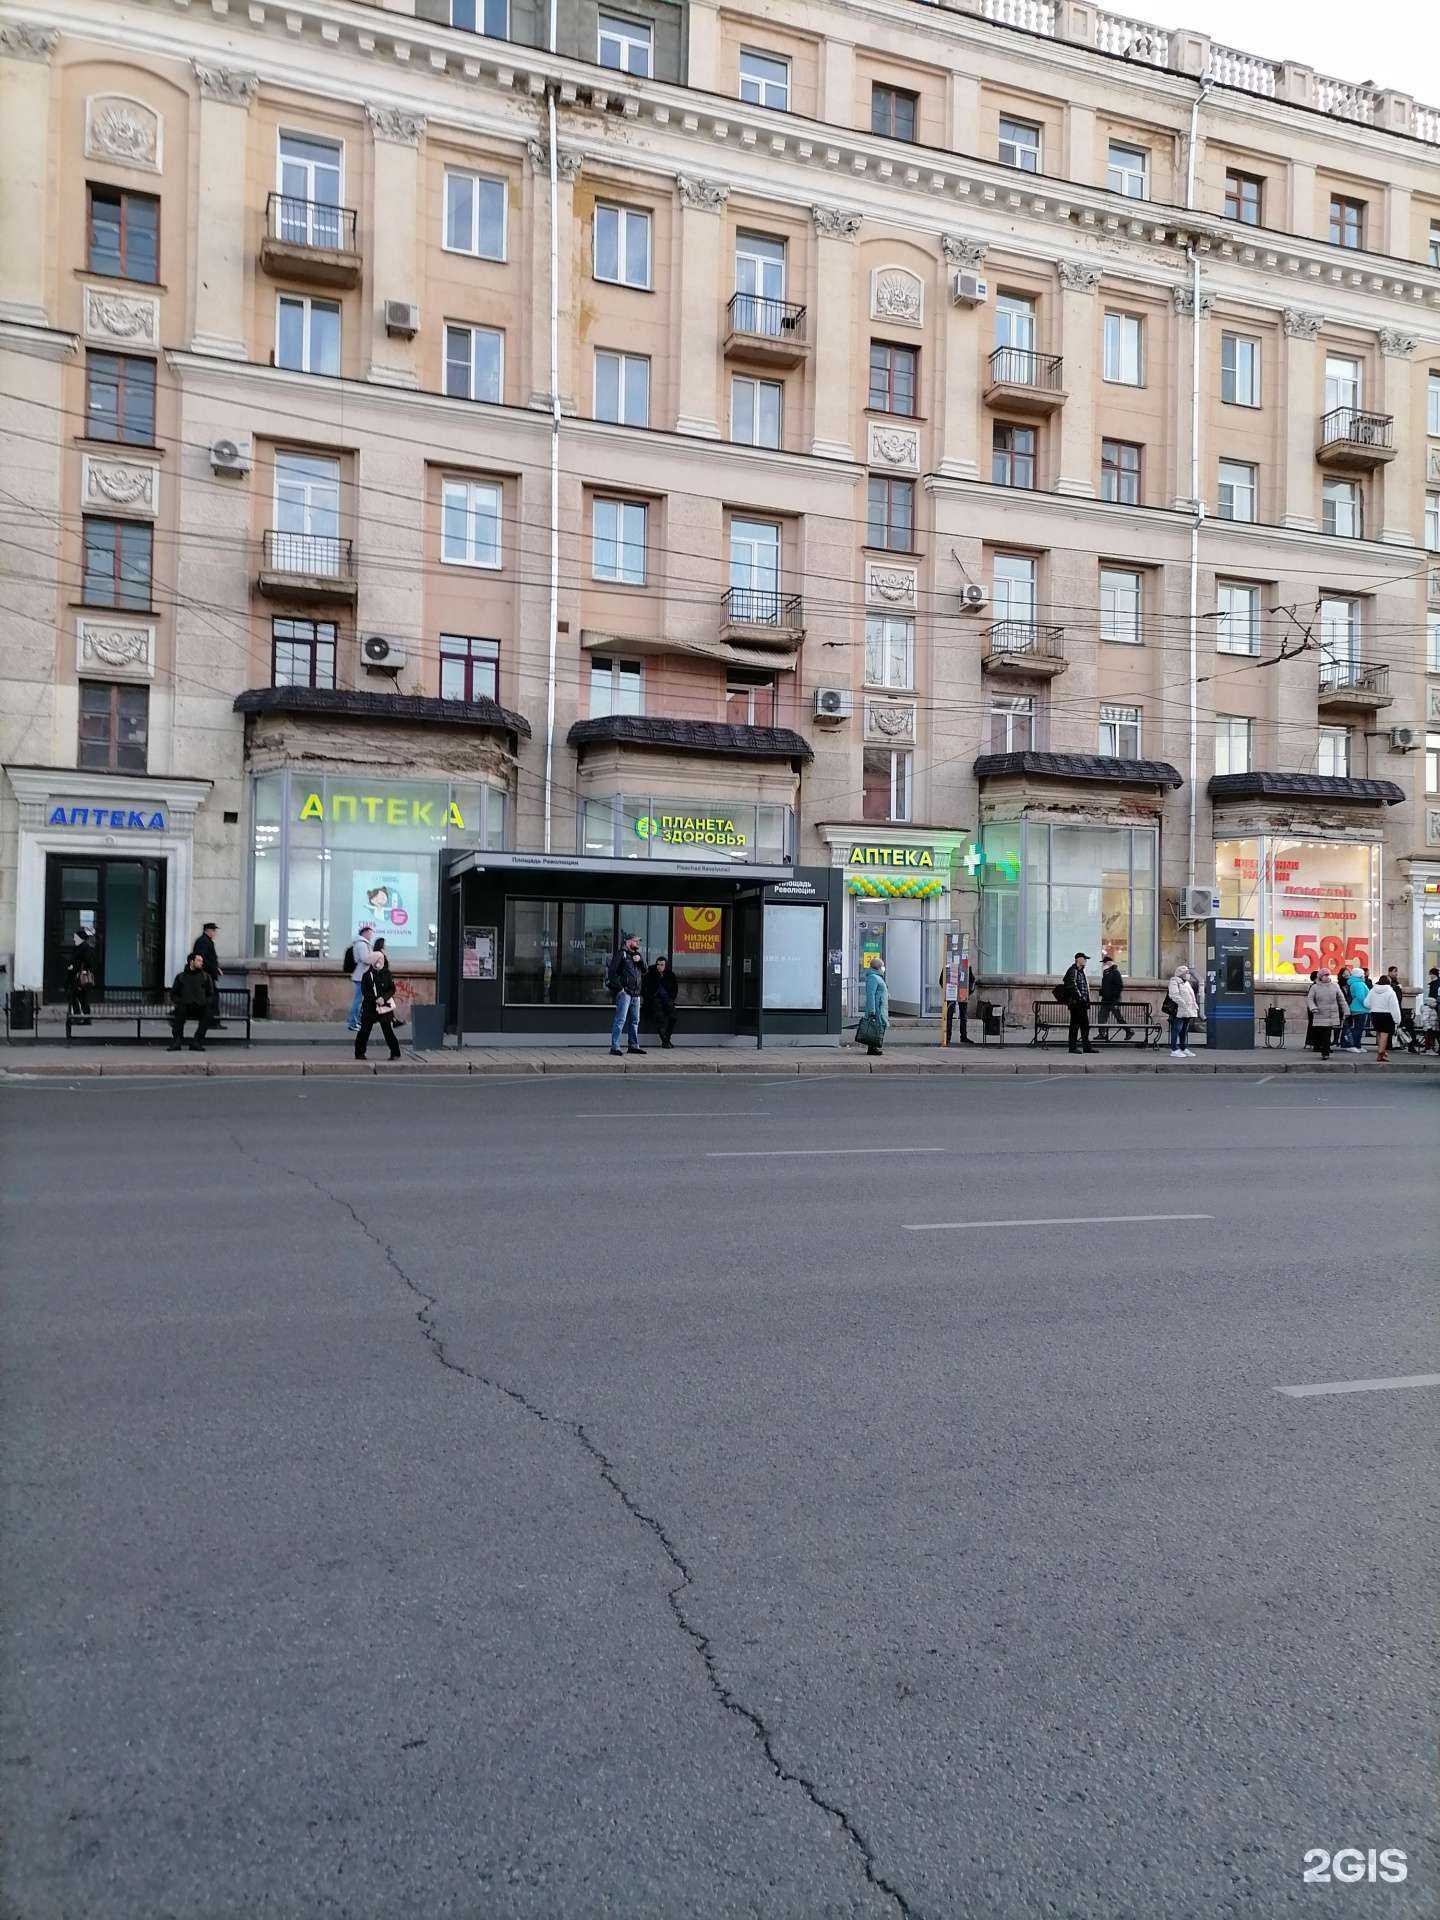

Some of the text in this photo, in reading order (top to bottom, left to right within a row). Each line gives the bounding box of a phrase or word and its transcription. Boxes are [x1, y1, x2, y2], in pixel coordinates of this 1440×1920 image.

[50, 806, 165, 830] АПТЕКА
[299, 793, 466, 829] АПТЕКА
[662, 815, 735, 833] ПЛАНЕТА
[662, 830, 747, 846] ЗДОРОВЬЯ
[511, 856, 579, 867] Площадь Революции
[850, 848, 933, 866] АПТЕКА
[774, 885, 816, 895] Революции
[1293, 935, 1369, 975] 585
